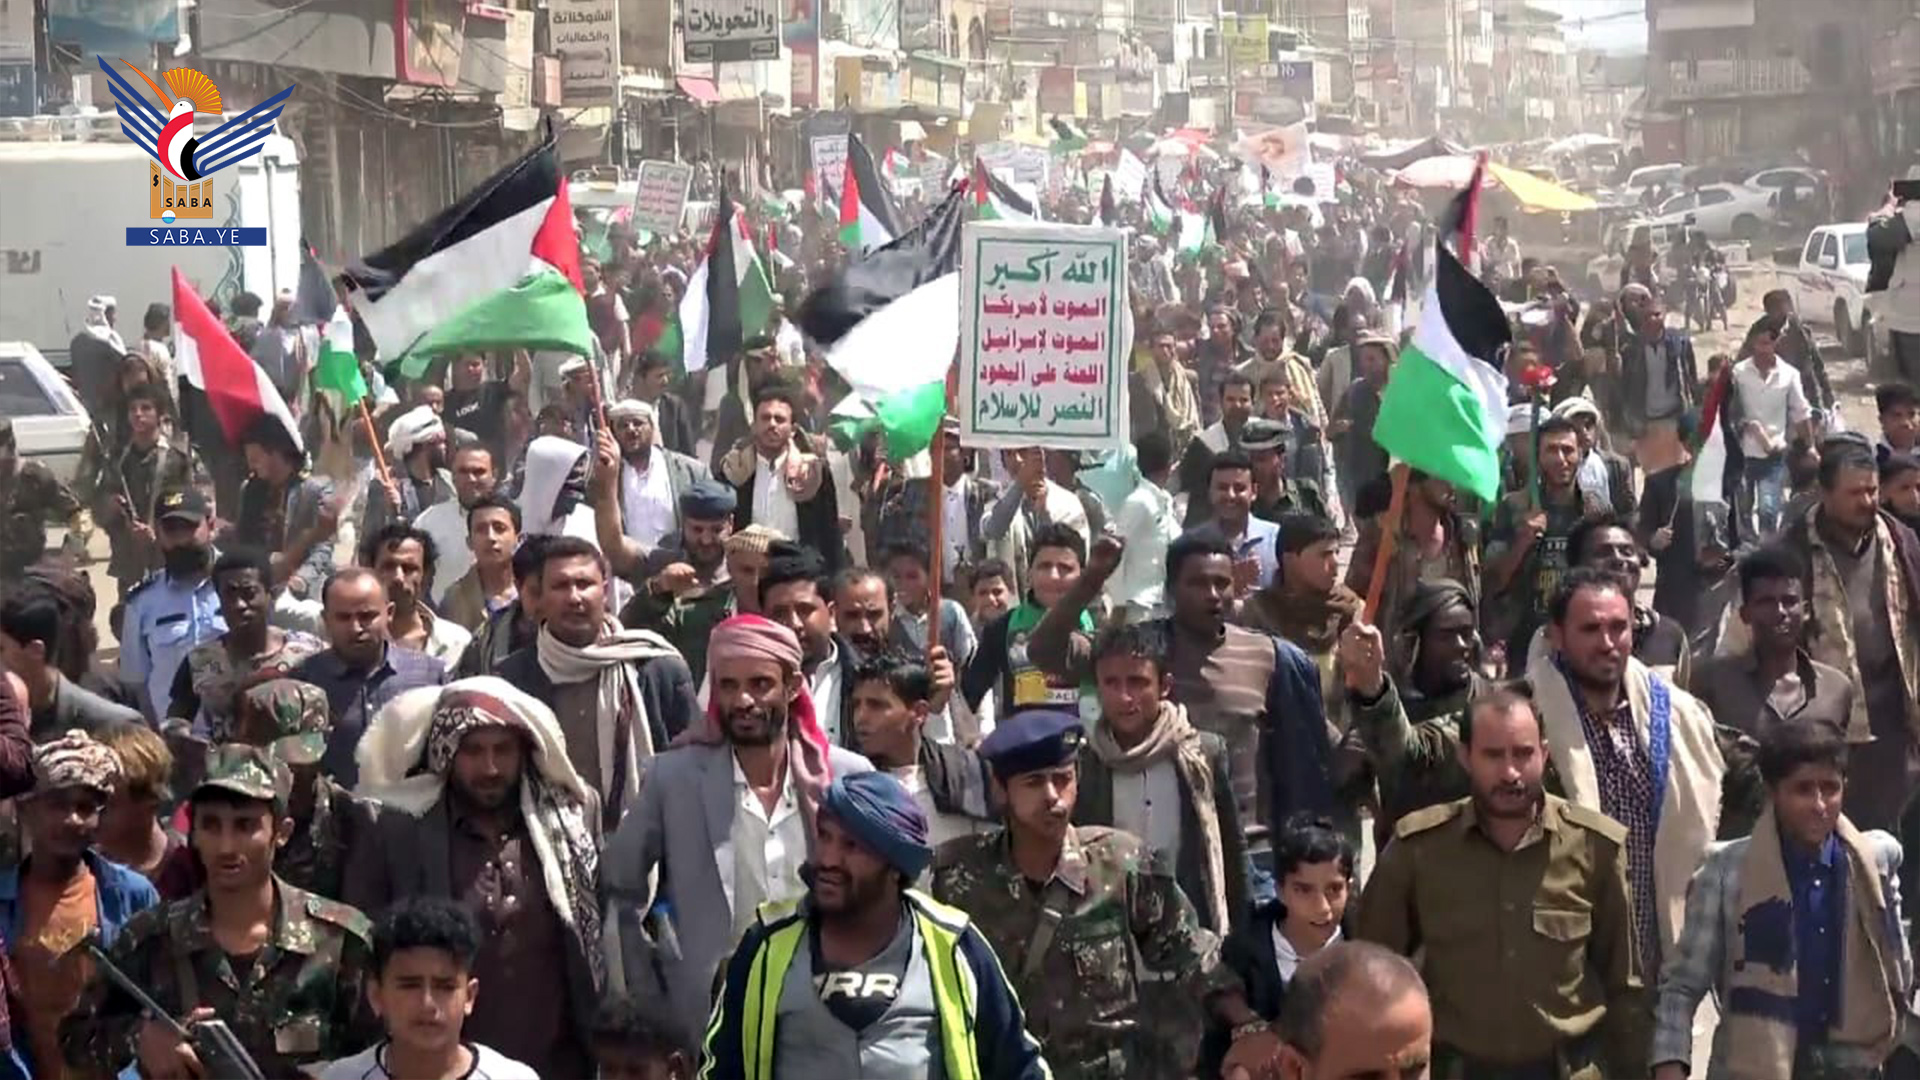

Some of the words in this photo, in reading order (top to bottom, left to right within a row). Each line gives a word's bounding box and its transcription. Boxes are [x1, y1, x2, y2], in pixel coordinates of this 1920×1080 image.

[688, 6, 773, 37] والتحويلات
[985, 247, 1059, 290] أكبر
[1062, 251, 1109, 284] الله
[1053, 297, 1106, 320] الموت
[982, 327, 1047, 355] لإسرائيل
[1052, 331, 1104, 352] الموت
[980, 362, 1026, 385] اليهود
[1031, 362, 1057, 387] على
[1063, 361, 1103, 385] اللعنة
[979, 391, 1042, 428] للإسلام
[1048, 392, 1103, 427] النصر
